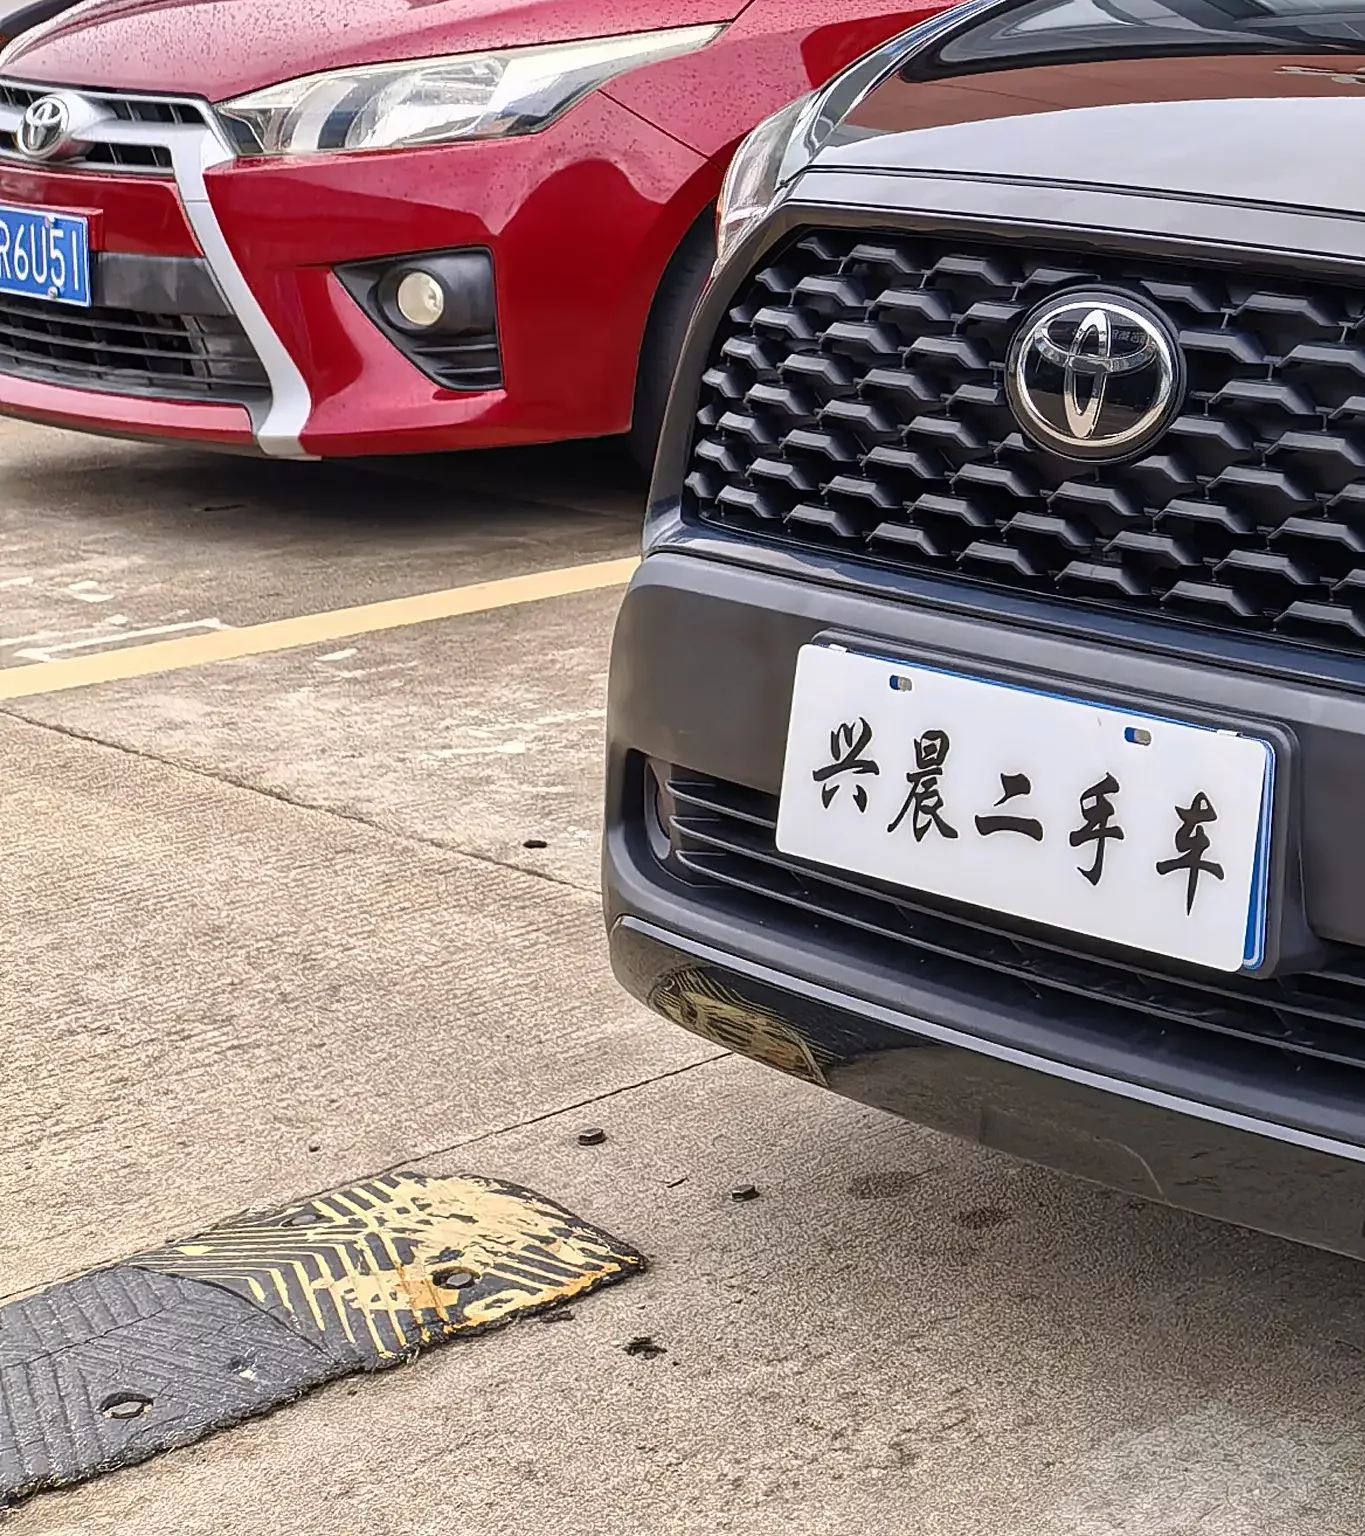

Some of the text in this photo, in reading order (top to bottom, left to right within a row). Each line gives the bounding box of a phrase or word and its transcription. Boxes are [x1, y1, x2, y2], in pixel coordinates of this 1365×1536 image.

[812, 716, 1225, 916] 兴晨二手车
